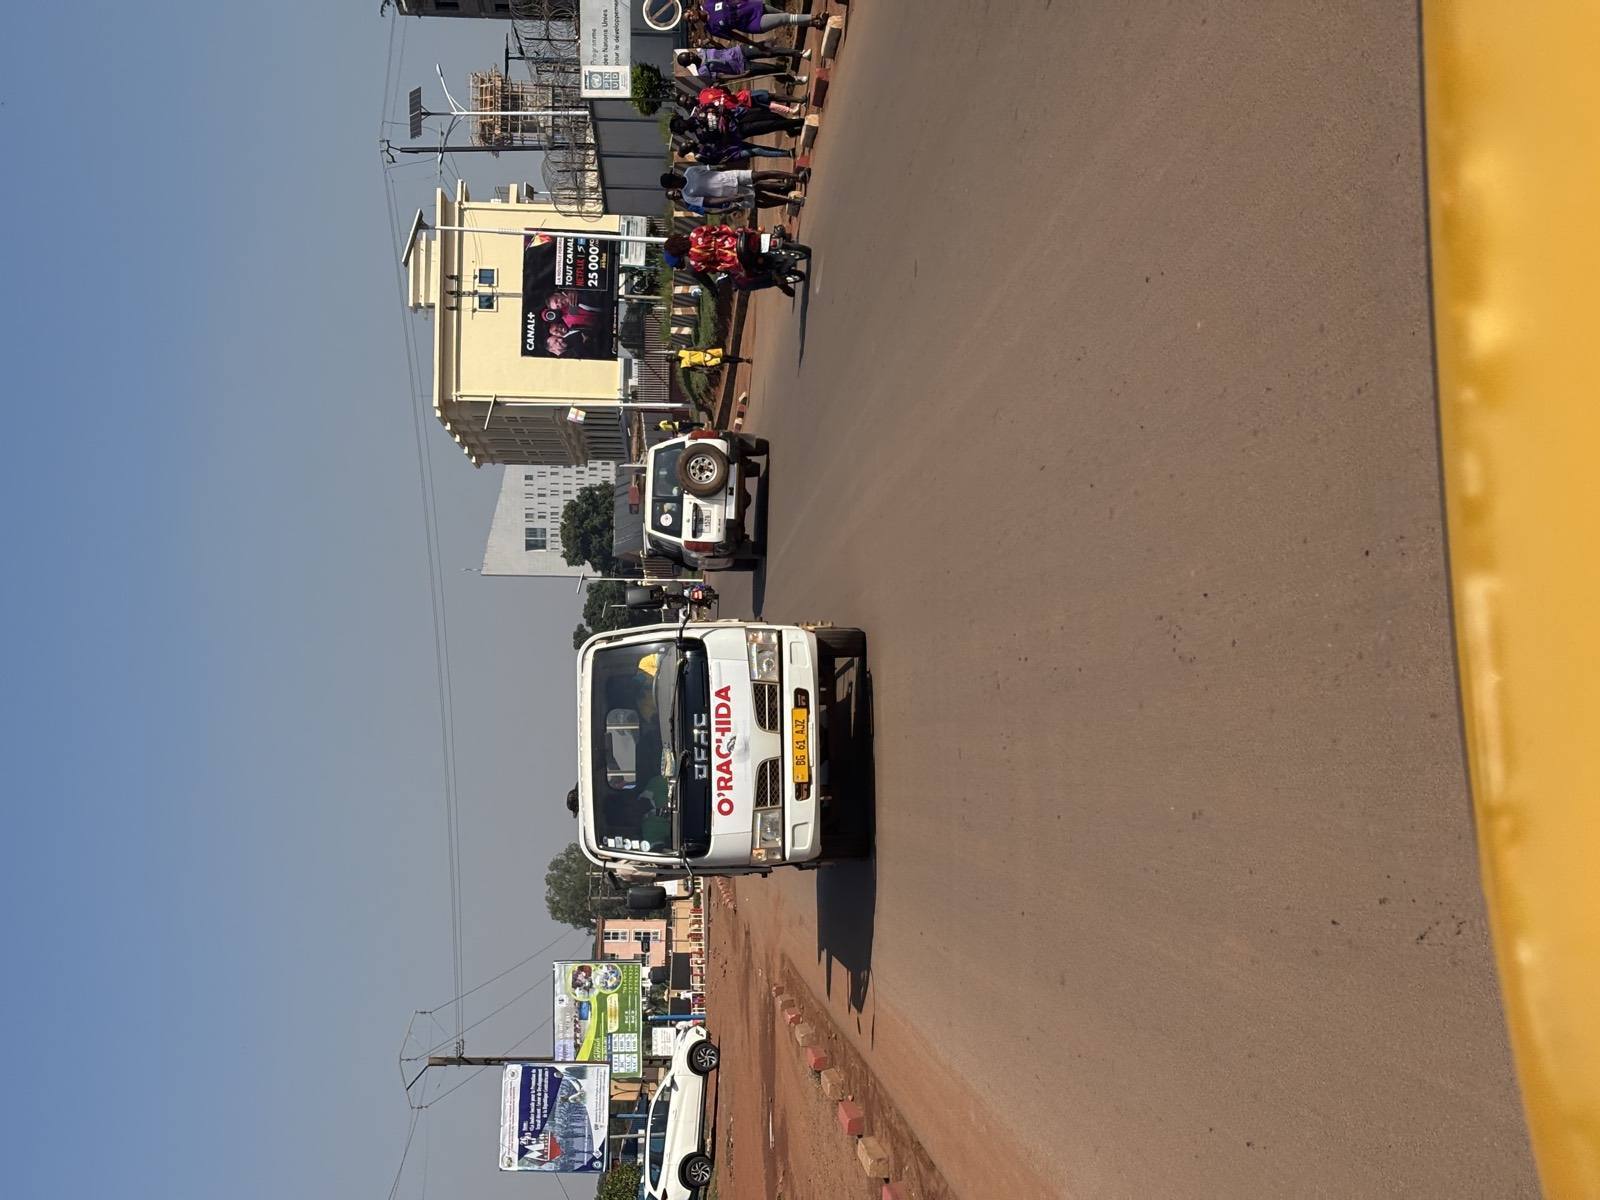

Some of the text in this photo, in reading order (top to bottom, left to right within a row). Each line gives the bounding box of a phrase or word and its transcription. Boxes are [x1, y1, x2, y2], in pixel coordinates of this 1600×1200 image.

[576, 259, 585, 286] NETFLIX
[587, 272, 598, 287] 25
[526, 312, 535, 350] CANAL+
[794, 719, 806, 766] BG 61 AJZ
